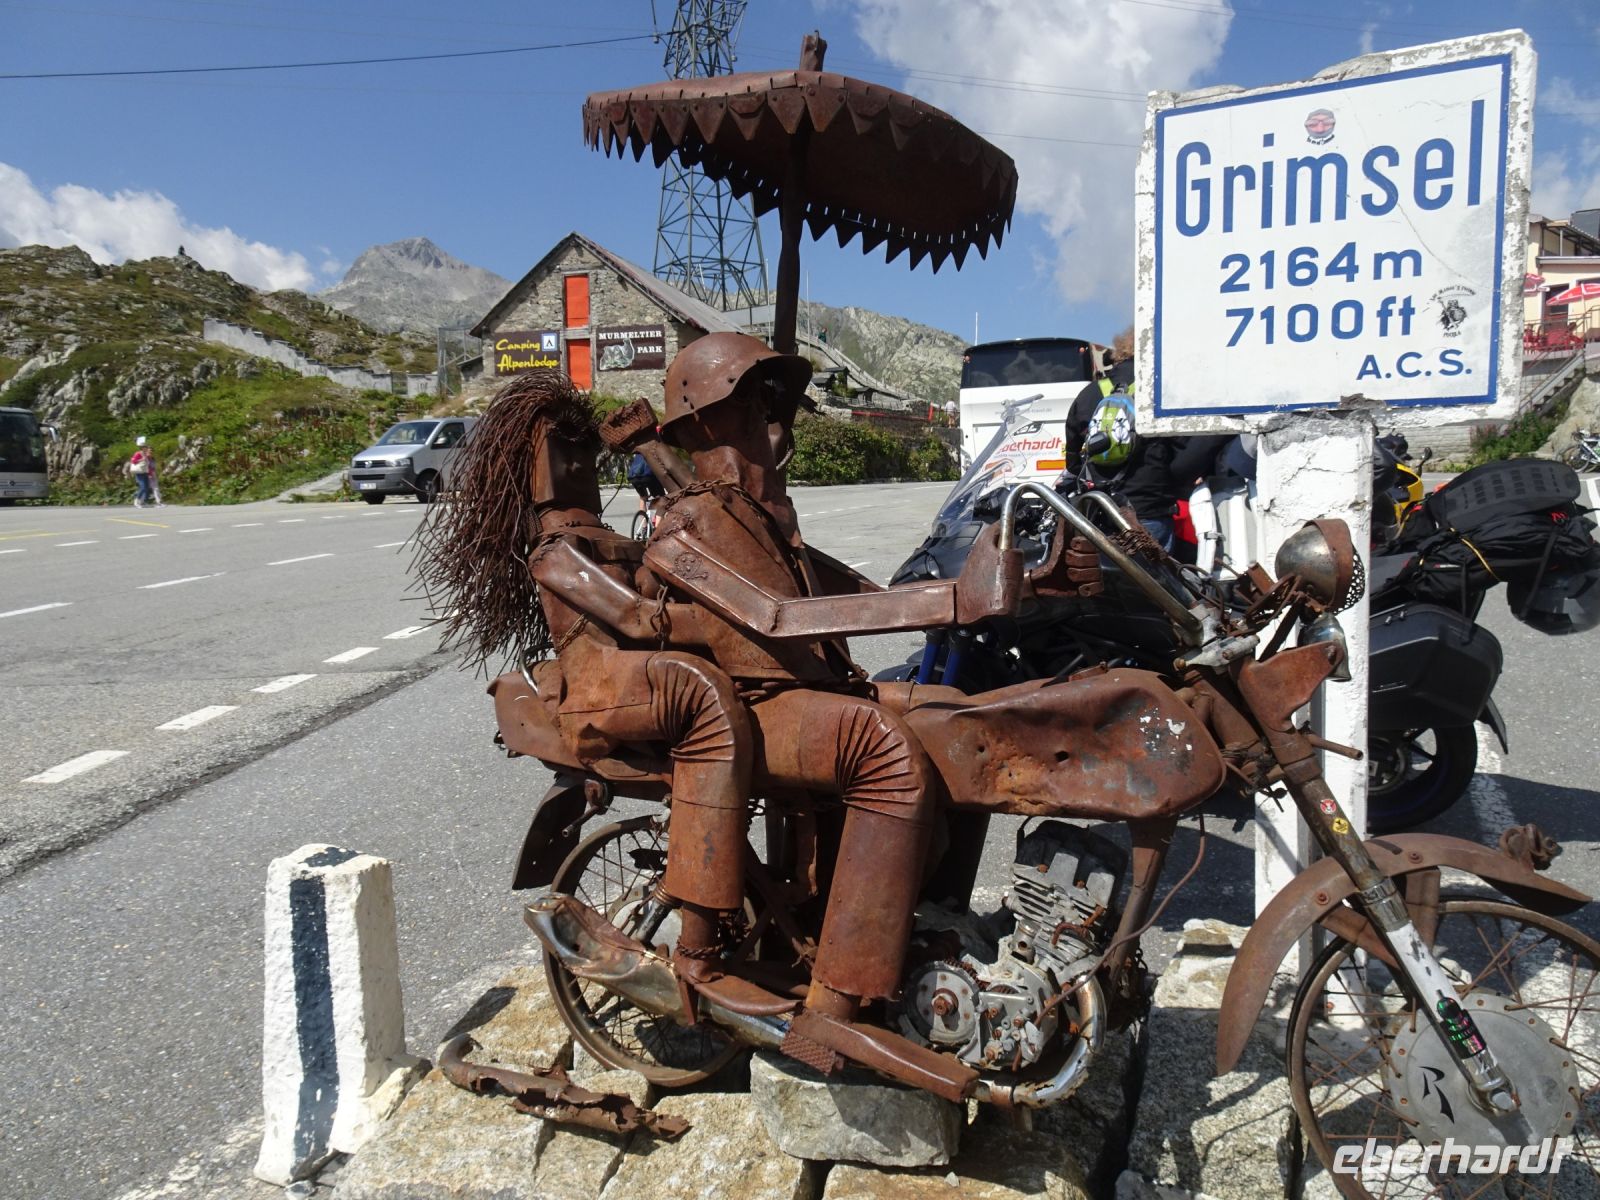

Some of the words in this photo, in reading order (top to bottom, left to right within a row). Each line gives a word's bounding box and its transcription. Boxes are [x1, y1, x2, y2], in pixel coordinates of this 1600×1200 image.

[1175, 99, 1485, 237] Grimsel
[598, 330, 663, 340] MURMELTIER
[495, 338, 541, 352] Camping
[637, 345, 663, 354] PARK
[497, 353, 559, 372] Alpenlodge
[1356, 348, 1473, 381] A.C.S.
